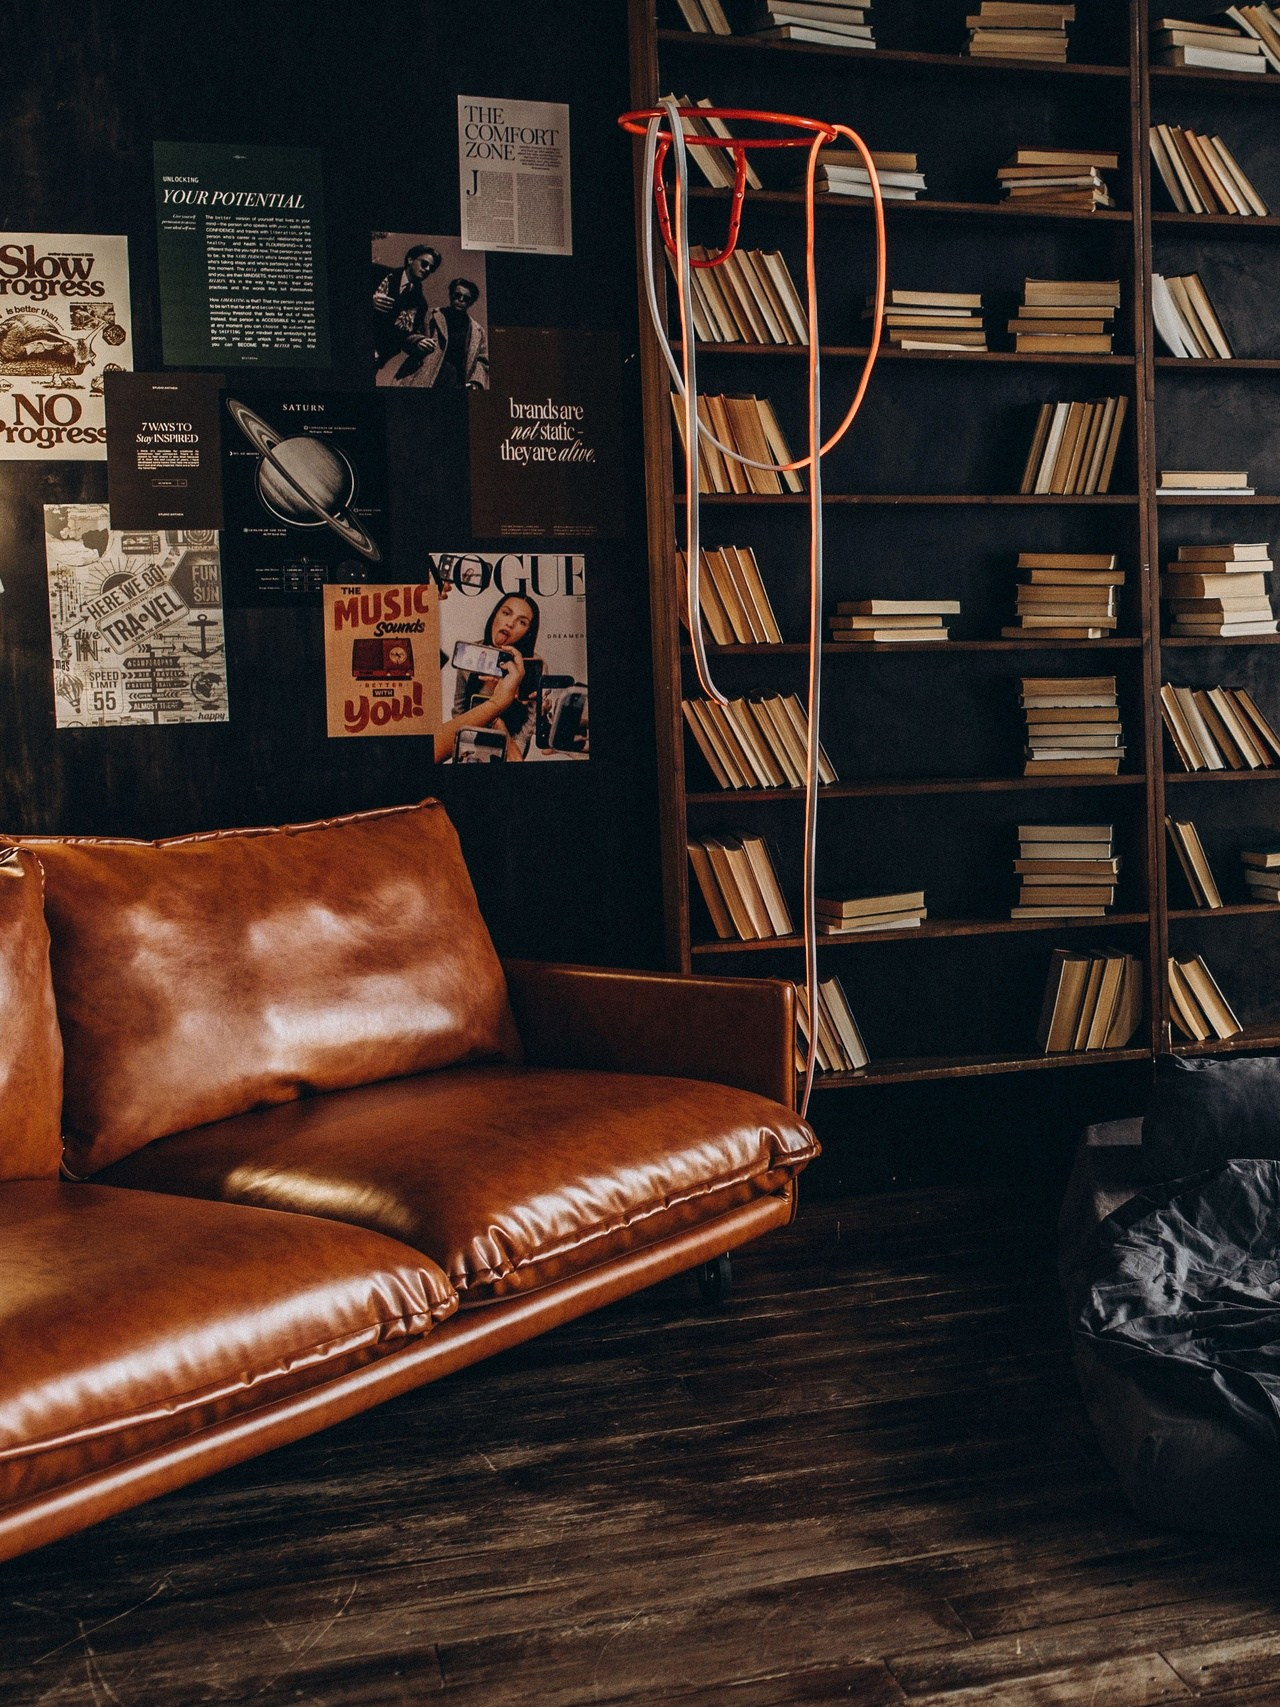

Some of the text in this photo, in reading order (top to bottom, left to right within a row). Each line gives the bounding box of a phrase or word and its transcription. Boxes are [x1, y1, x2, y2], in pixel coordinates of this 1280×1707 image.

[464, 105, 504, 124] THE
[465, 124, 559, 146] COMFORT
[465, 142, 515, 161] ZONE
[163, 176, 199, 184] UNLOCKING
[466, 170, 479, 196] J
[162, 190, 305, 209] YOUR POTENTIAL
[0, 244, 95, 280] Slow
[0, 278, 105, 301] rogress
[6, 307, 14, 315] is
[14, 305, 40, 314] better
[11, 393, 82, 426] NO
[282, 404, 325, 412] SATURN
[509, 397, 583, 420] brands are
[0, 419, 107, 449] rogress
[142, 422, 192, 432] 7 WAYS TO
[510, 421, 539, 440] not
[540, 422, 575, 441] static
[136, 434, 199, 444] Stay INSPIRED
[500, 439, 596, 466] they are alive.
[192, 565, 218, 581] FUN
[428, 553, 586, 596] VOGUE
[86, 594, 124, 619] HERE
[120, 579, 145, 600] WE
[144, 565, 166, 588] GO!
[193, 586, 220, 602] SUN
[341, 587, 361, 595] THE
[334, 584, 429, 631] MUSIC
[74, 629, 101, 639] dive
[373, 618, 425, 637] Sounds
[76, 640, 98, 662] IN
[89, 672, 119, 681] SPEED
[94, 691, 116, 711] 55
[198, 712, 225, 720] happy
